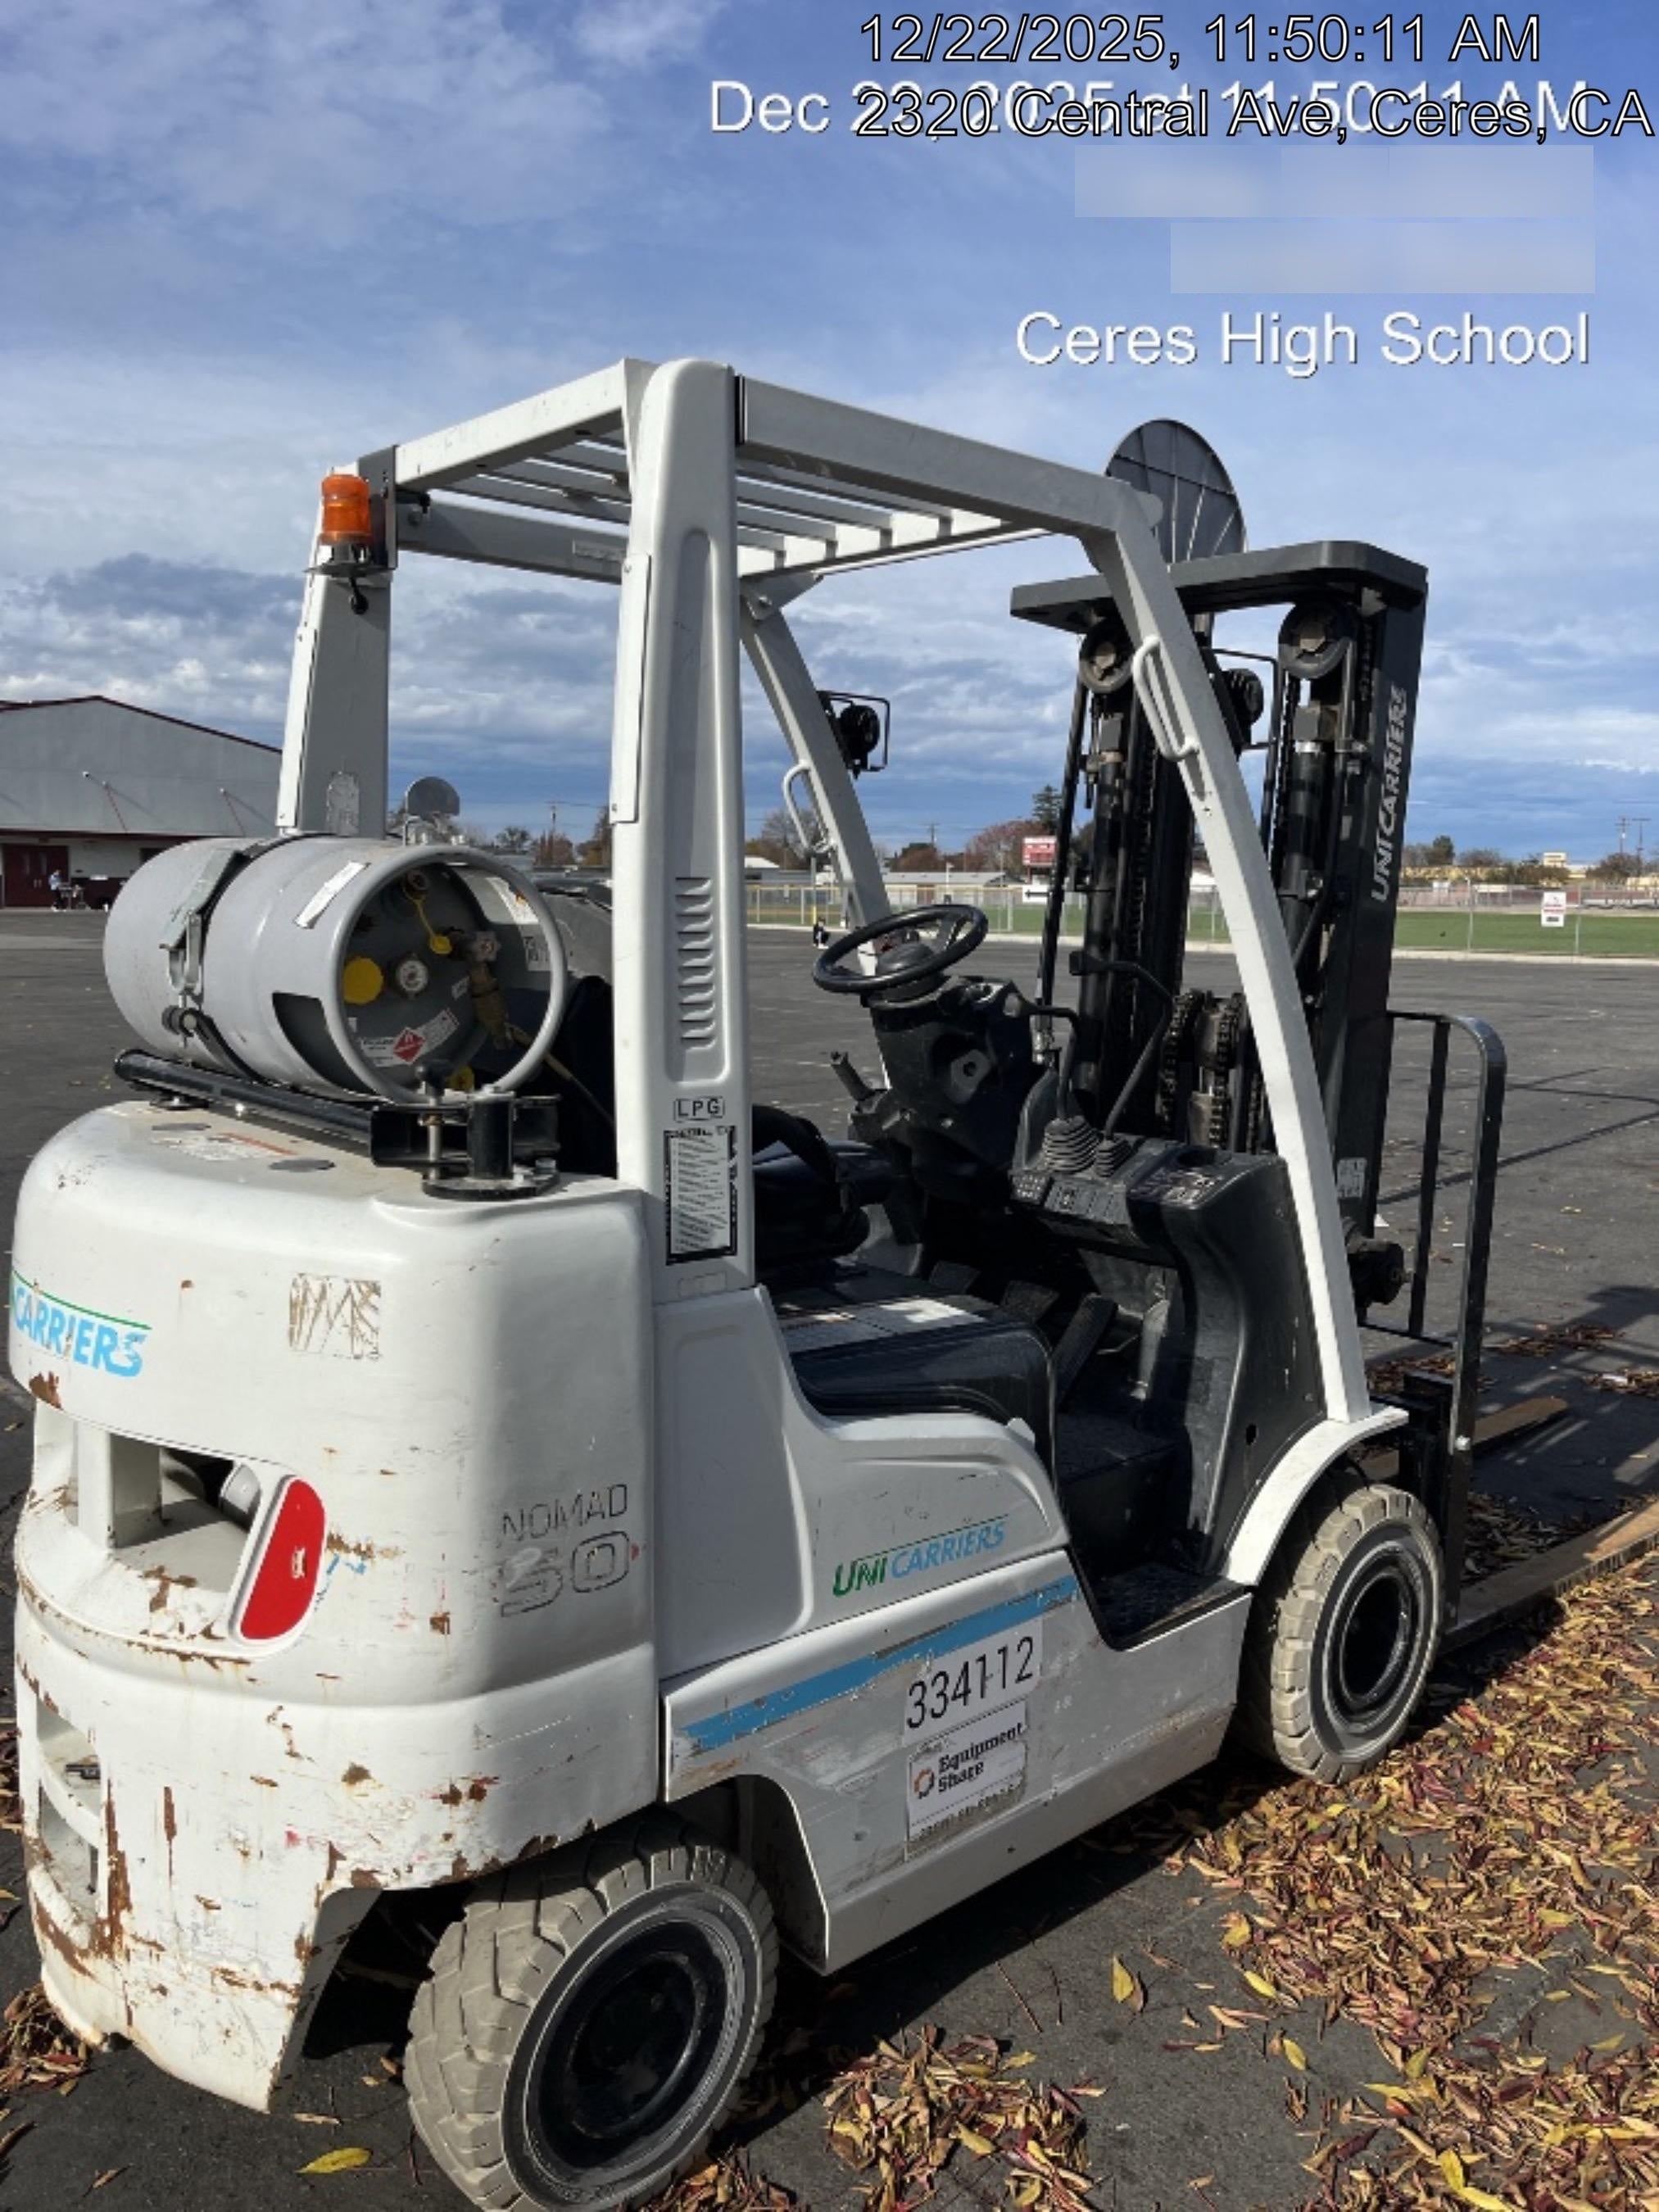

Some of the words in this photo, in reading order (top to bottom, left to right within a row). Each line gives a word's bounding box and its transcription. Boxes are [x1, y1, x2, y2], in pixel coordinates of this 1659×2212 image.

[1371, 685, 1407, 903] UNICARRIERS
[676, 1098, 722, 1117] LPG
[502, 1484, 628, 1542] NOMAD
[905, 1635, 1035, 1729] 334112
[938, 1722, 1023, 1775] Equipment
[938, 1761, 985, 1793] Share
